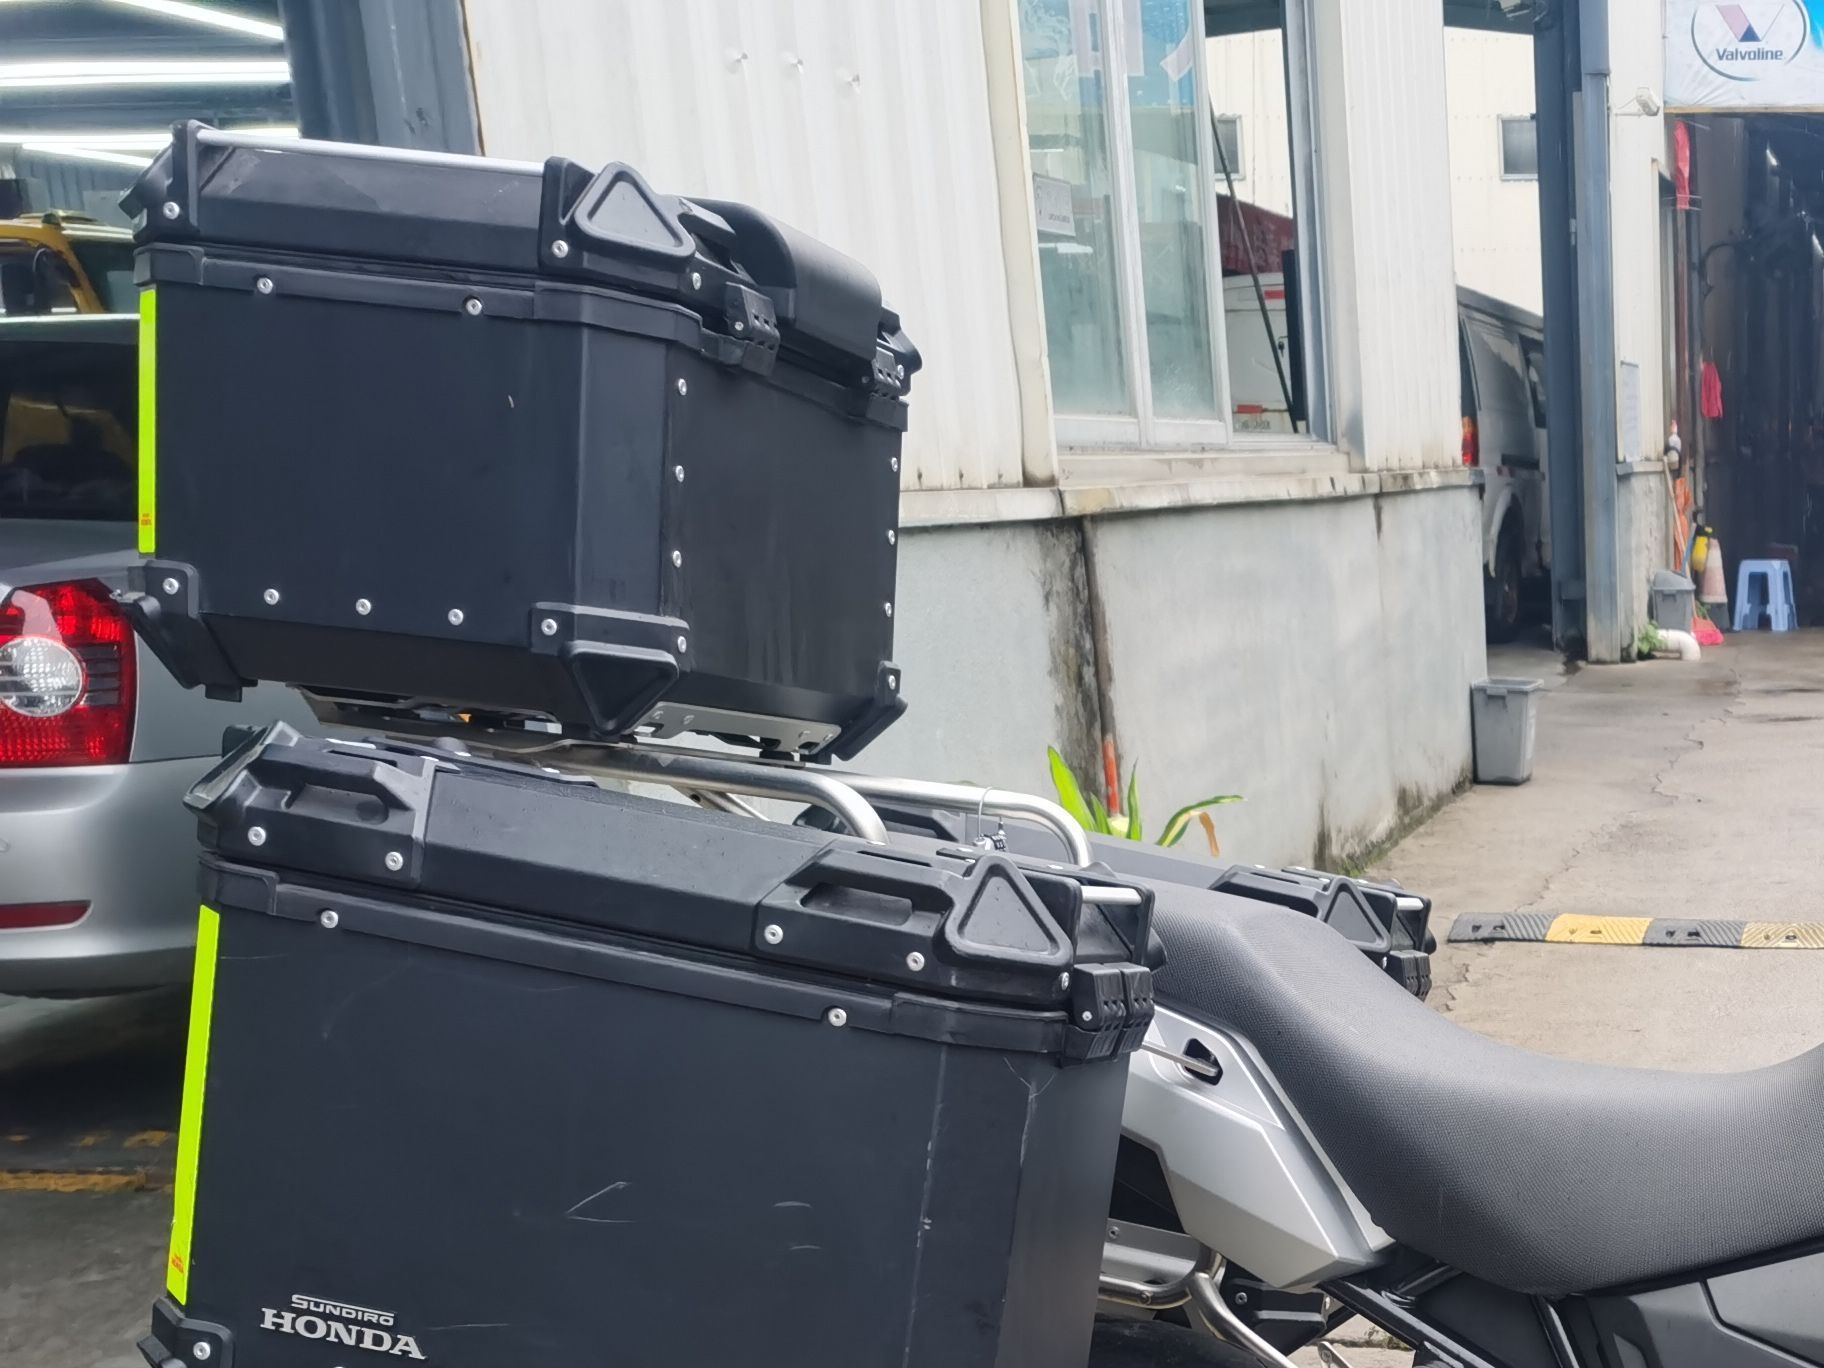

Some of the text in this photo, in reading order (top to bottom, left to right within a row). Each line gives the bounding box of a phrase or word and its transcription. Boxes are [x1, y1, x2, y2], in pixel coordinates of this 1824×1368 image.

[1716, 48, 1783, 61] Valvoline
[291, 1294, 395, 1326] SUNDIRO
[260, 1307, 426, 1360] HONDA
